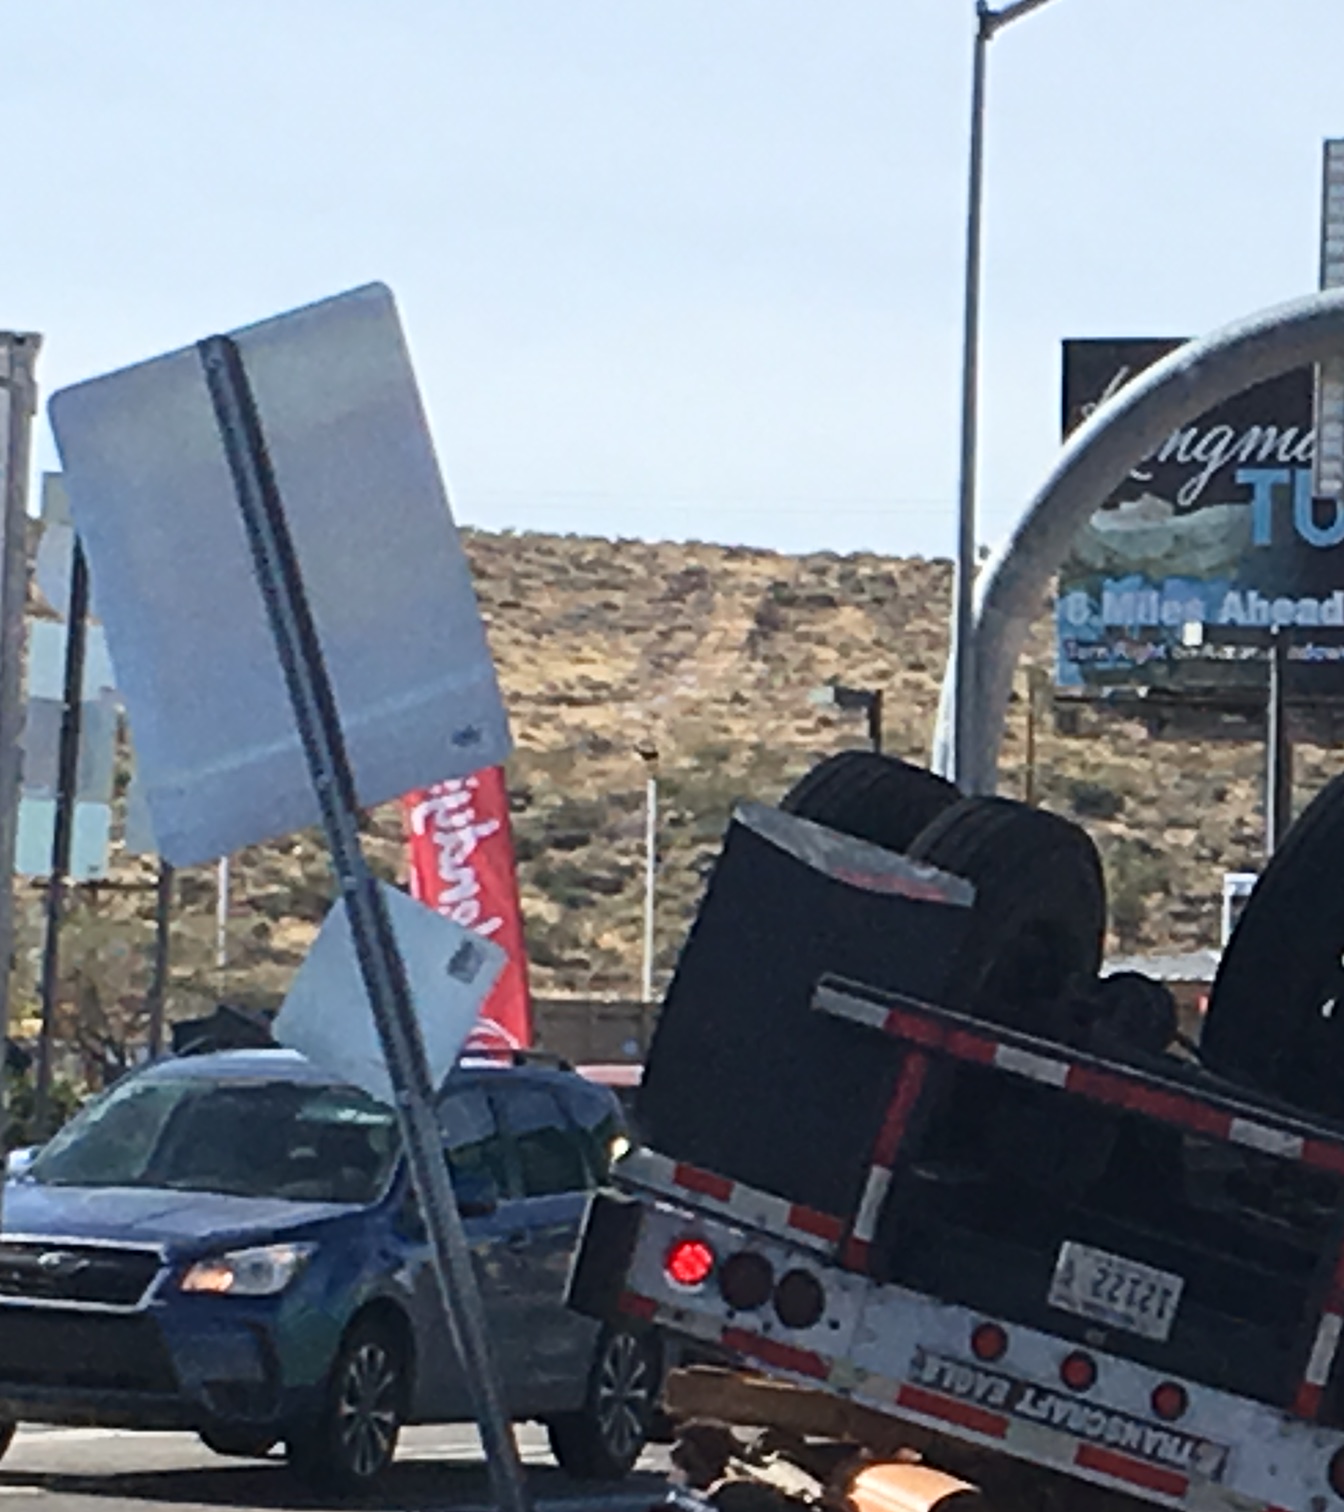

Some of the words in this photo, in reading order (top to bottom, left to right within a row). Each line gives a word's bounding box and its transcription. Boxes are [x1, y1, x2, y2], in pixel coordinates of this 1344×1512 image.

[1102, 590, 1203, 625] Miles
[1220, 589, 1344, 626] Ahead
[920, 1356, 1011, 1407] EAGLE
[1015, 1387, 1195, 1467] TRANSCRAFT
